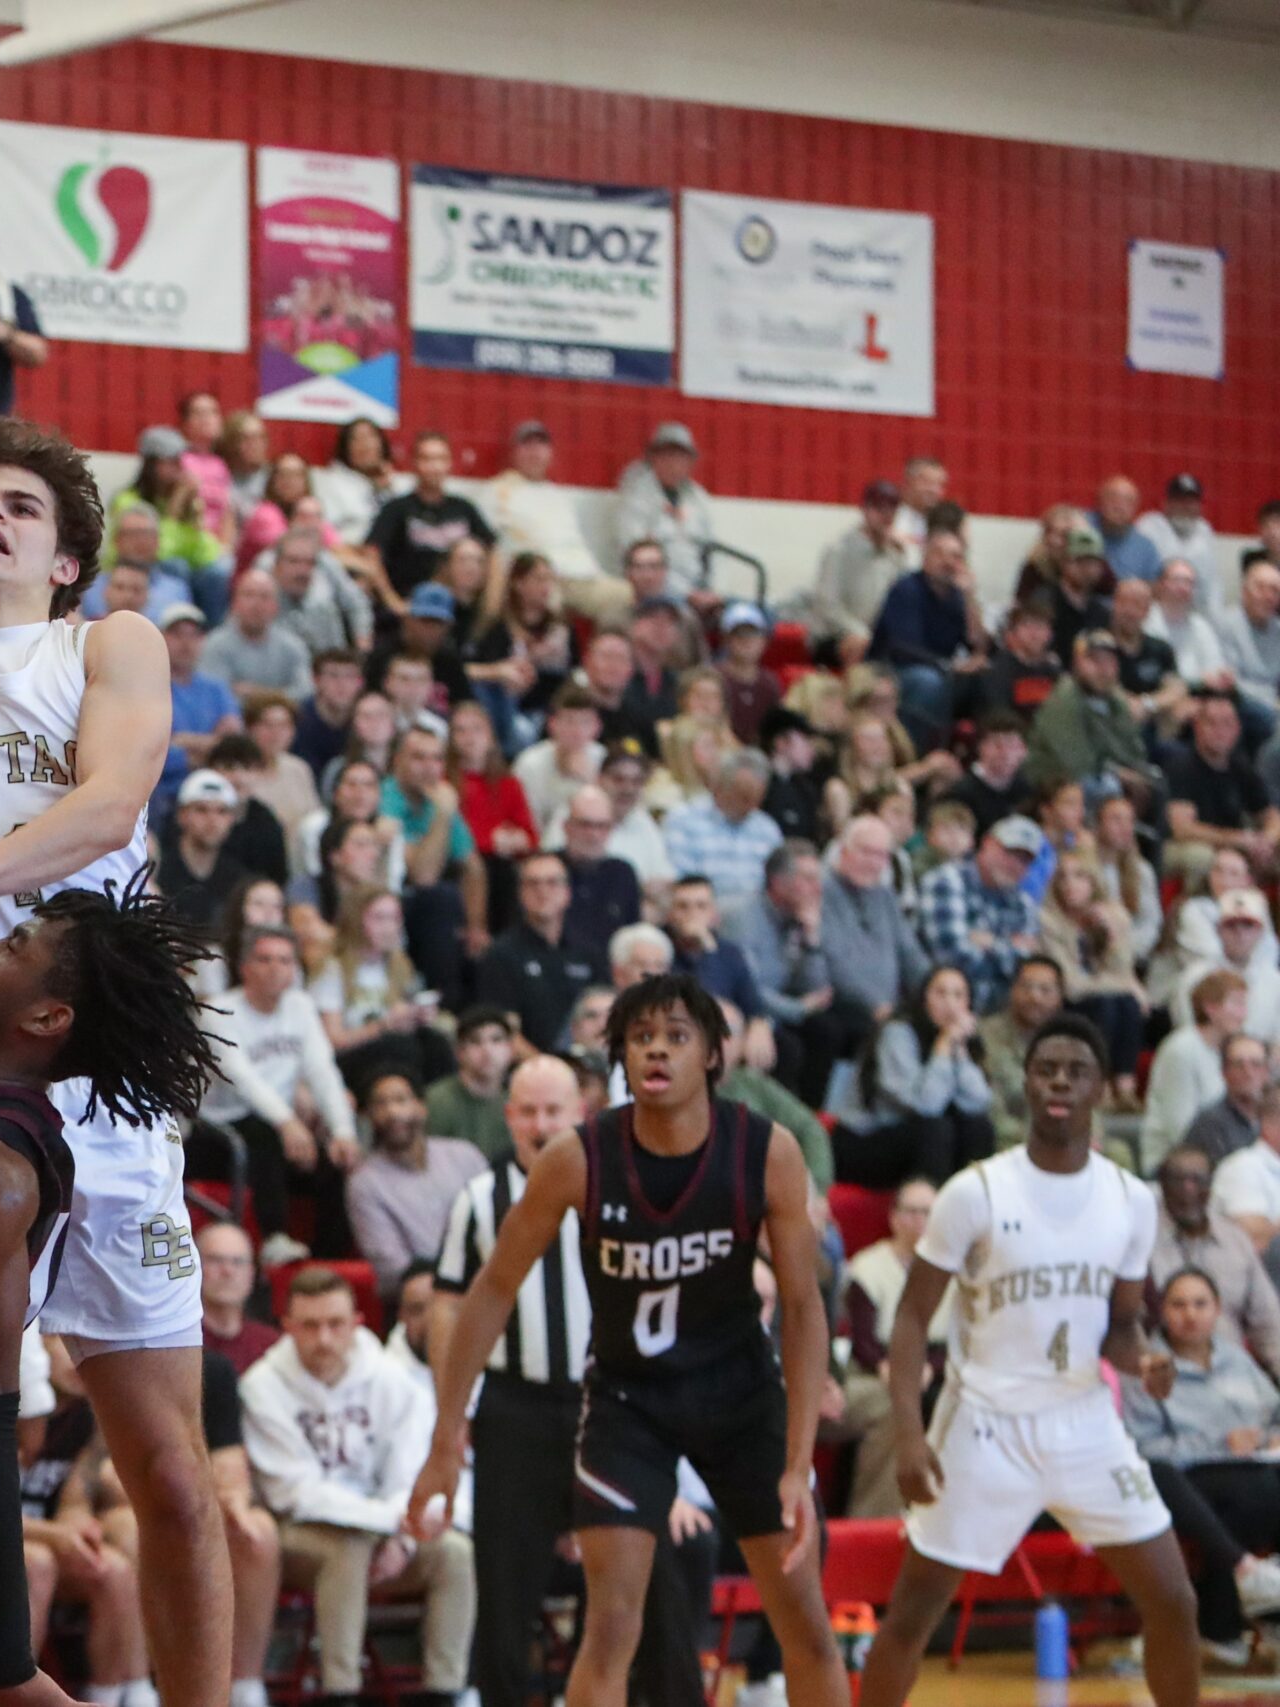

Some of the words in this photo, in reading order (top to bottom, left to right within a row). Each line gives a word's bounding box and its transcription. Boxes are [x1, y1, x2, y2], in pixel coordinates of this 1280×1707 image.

[471, 211, 659, 267] SANDOZ
[141, 1213, 196, 1280] BE
[600, 1229, 734, 1281] CROSS
[633, 1282, 680, 1358] 0
[1047, 1320, 1070, 1373] 4
